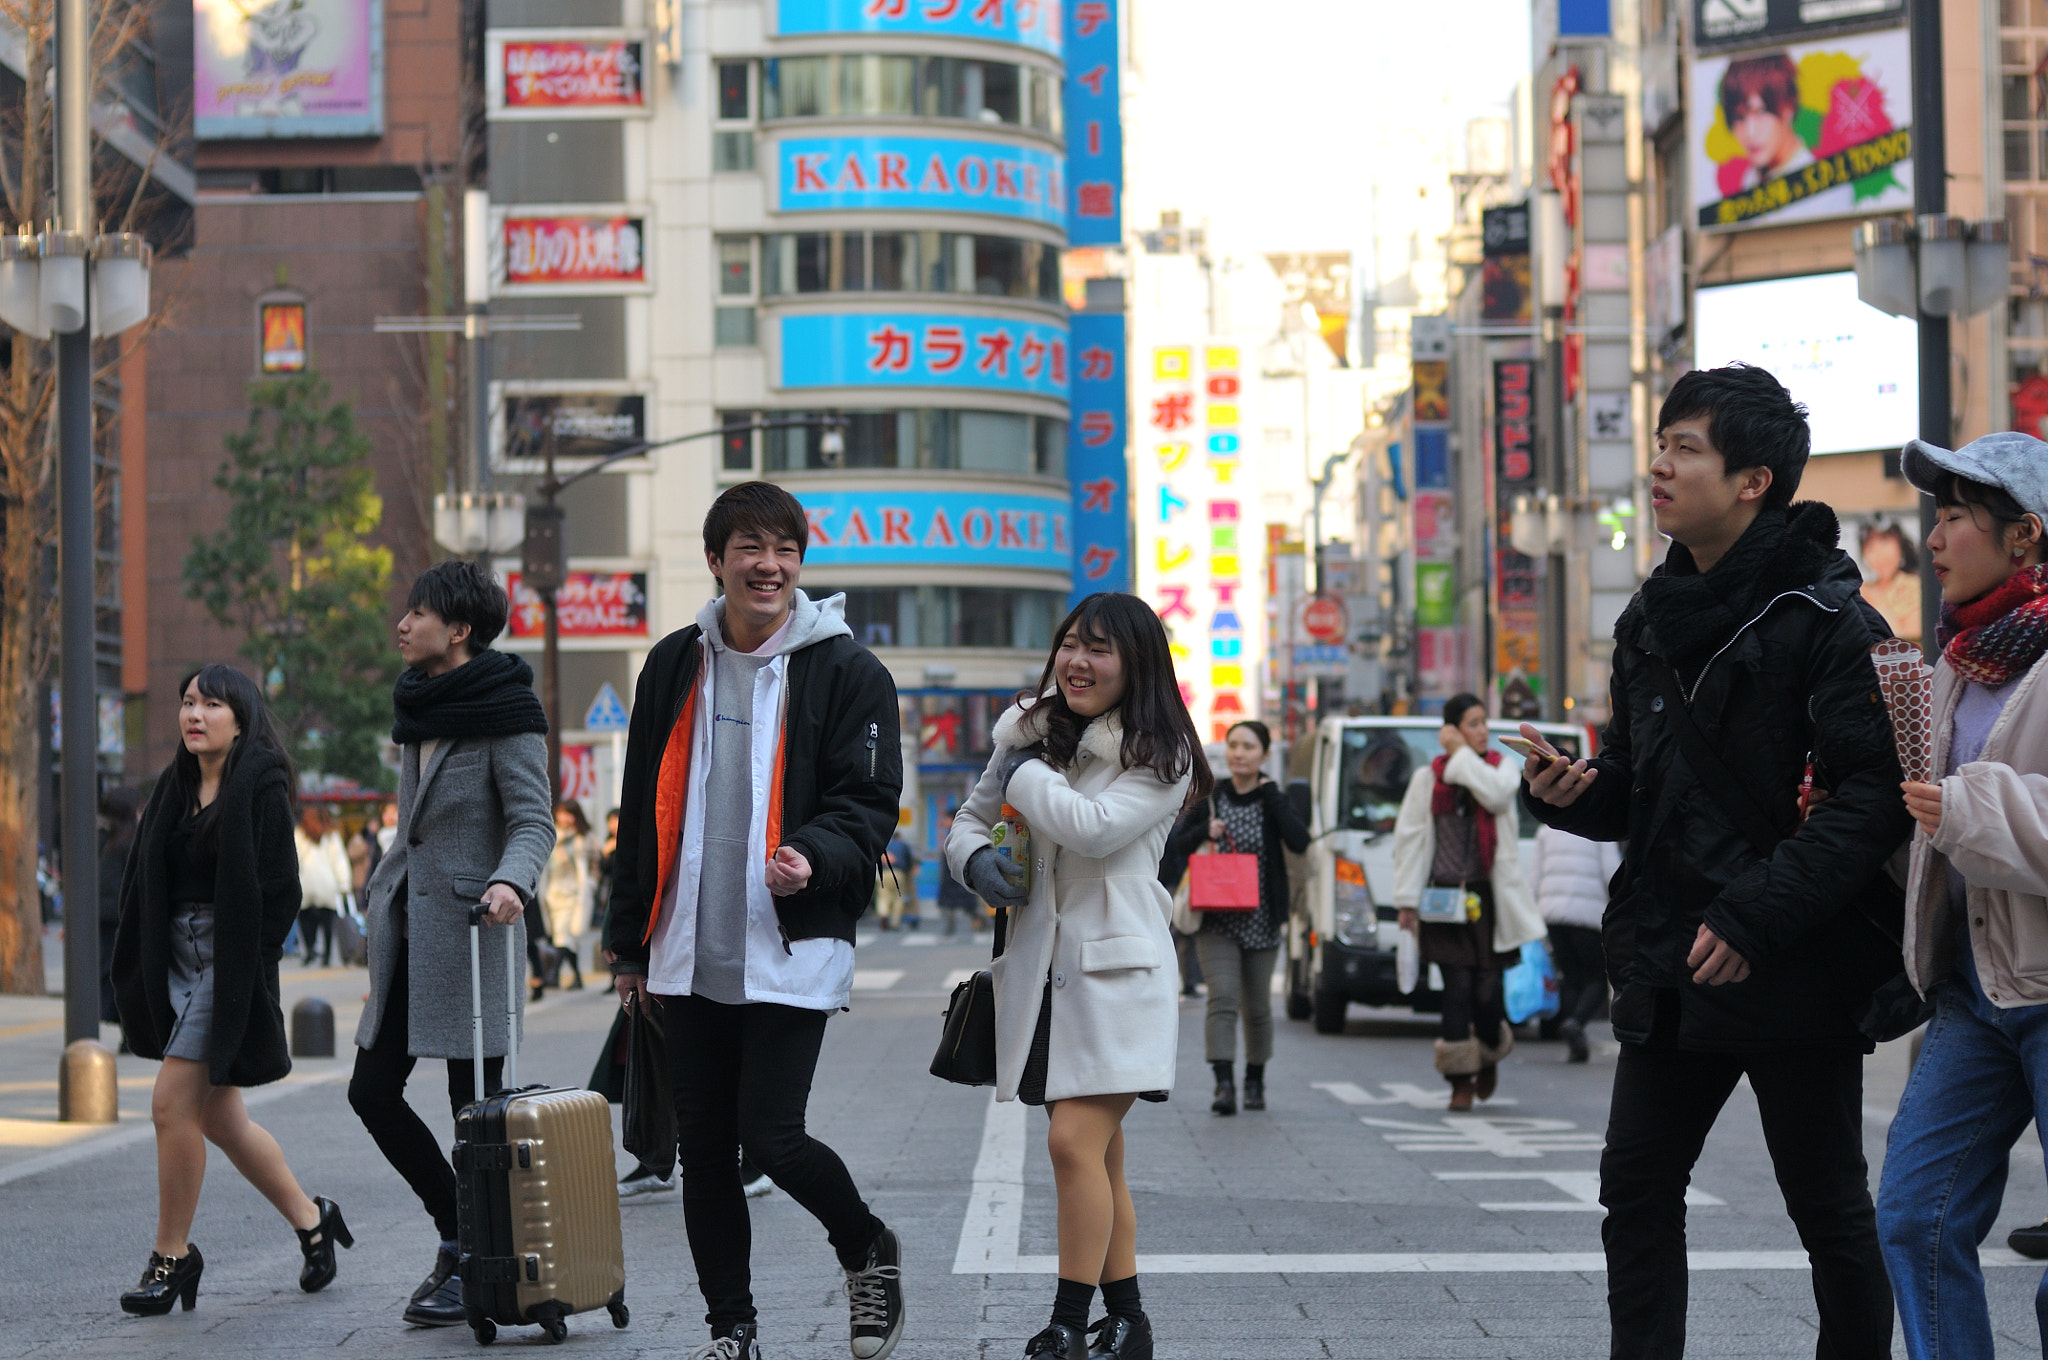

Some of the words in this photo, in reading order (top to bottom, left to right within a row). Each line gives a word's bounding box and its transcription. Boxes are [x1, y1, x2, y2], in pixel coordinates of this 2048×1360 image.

[792, 153, 1041, 201] KARAOKE
[1206, 346, 1241, 484] ROBOT
[803, 505, 1046, 551] KARAOKE
[714, 713, 751, 727] Champion
